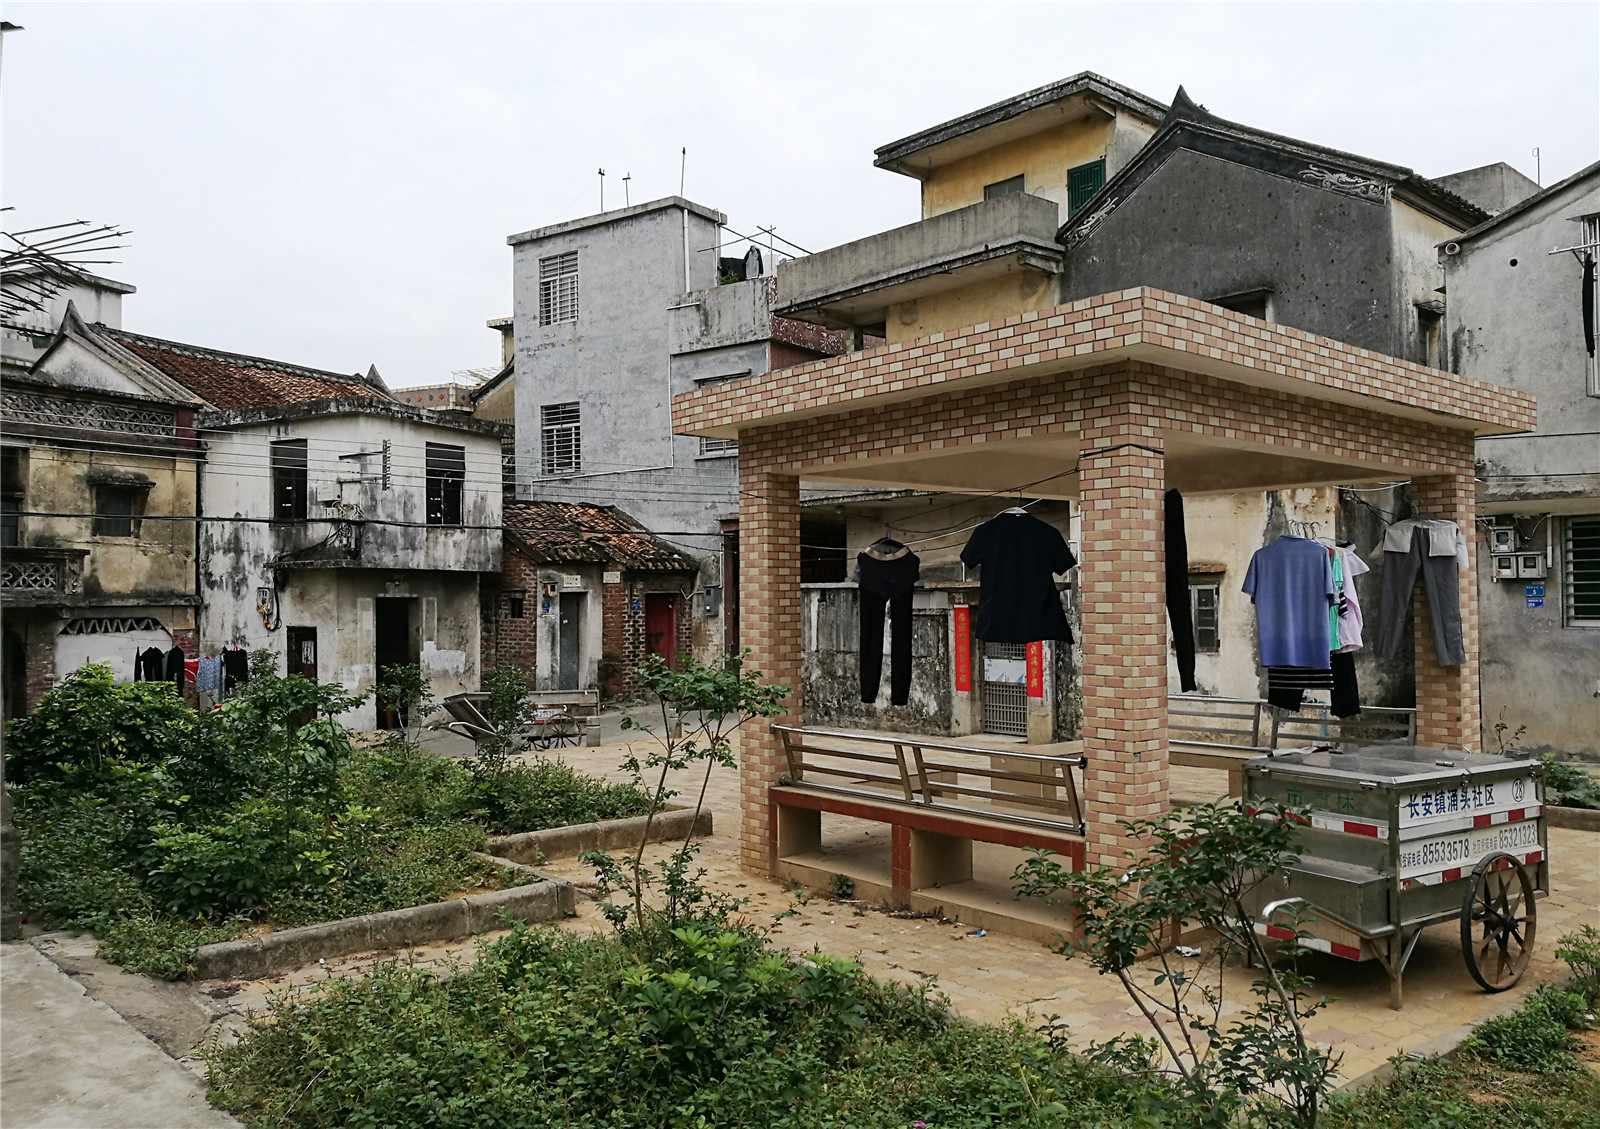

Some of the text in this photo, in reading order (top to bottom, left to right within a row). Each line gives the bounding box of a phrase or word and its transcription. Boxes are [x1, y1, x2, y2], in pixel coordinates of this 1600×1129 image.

[1408, 784, 1494, 818] 长安镇涌头社区
[1513, 781, 1524, 800] 28
[1422, 838, 1470, 865] 85533578
[1499, 825, 1536, 849] 85321323
